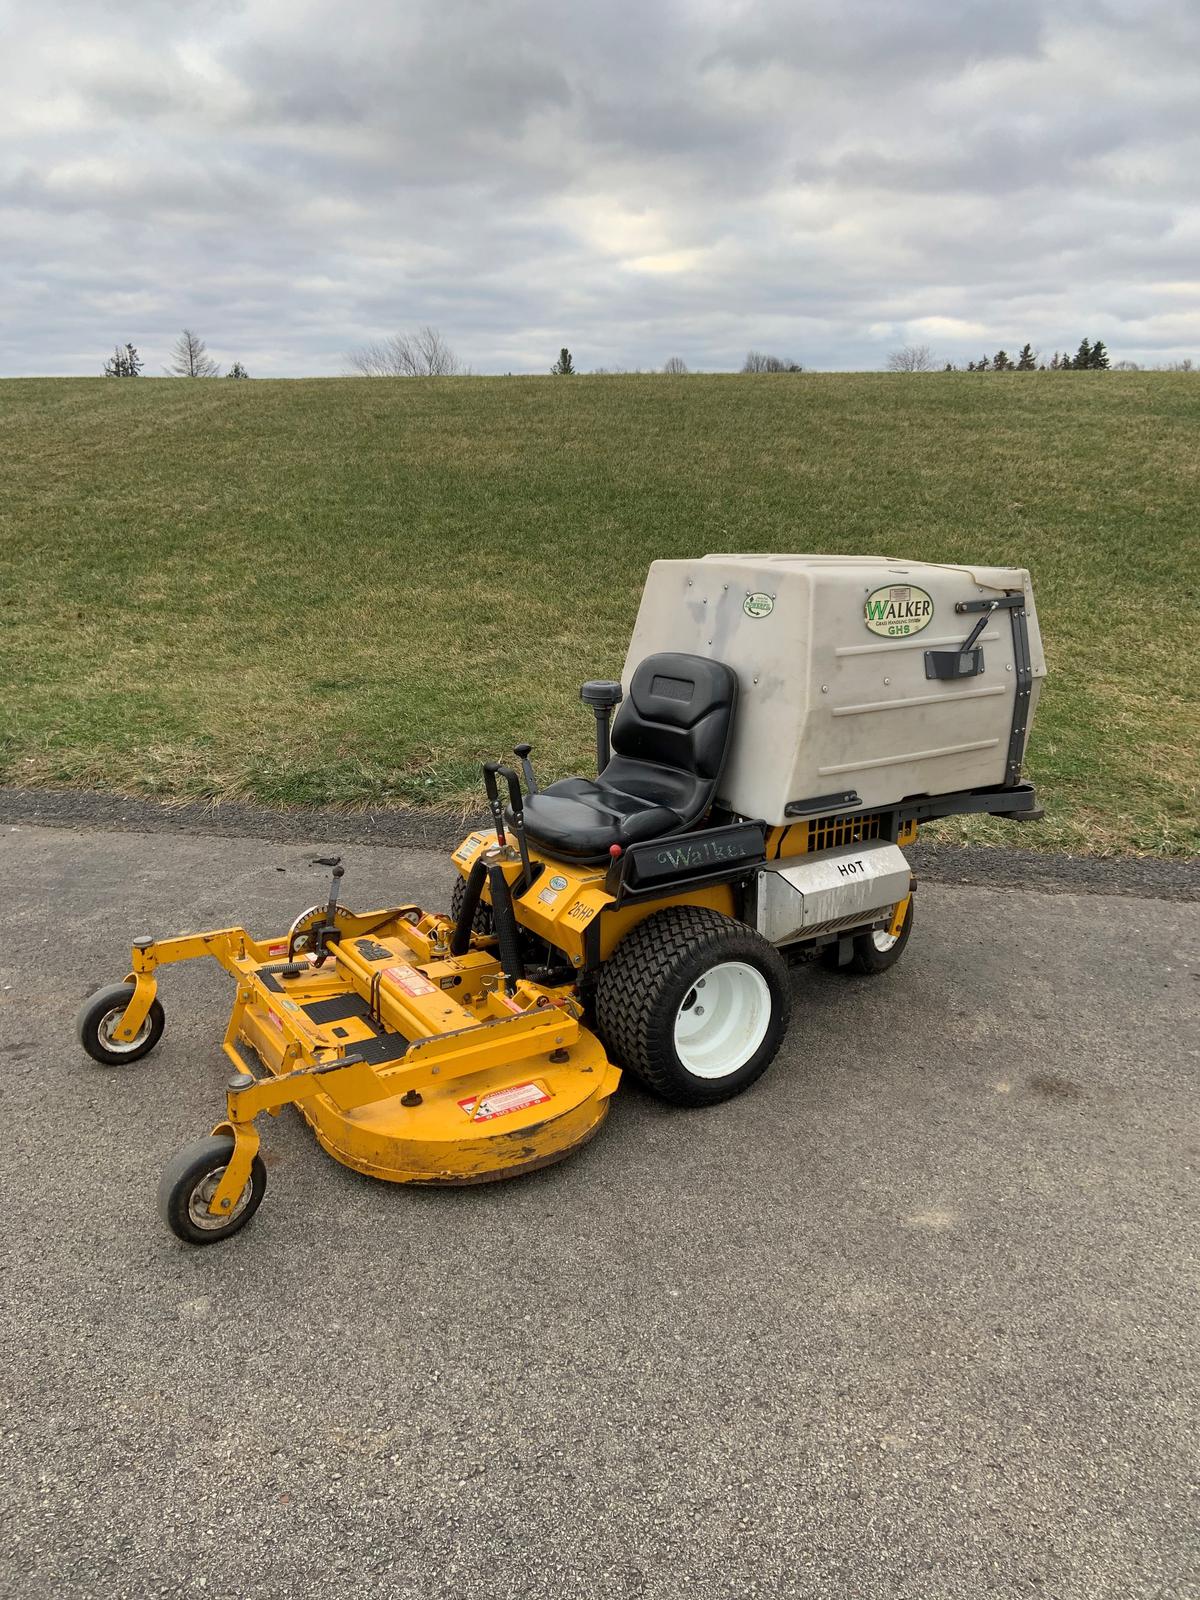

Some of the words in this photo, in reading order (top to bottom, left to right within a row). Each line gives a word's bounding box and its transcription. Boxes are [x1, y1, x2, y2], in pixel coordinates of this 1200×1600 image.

[867, 600, 930, 620] WALKER
[888, 624, 910, 635] GHS
[837, 860, 865, 876] HOT
[567, 901, 595, 922] 26HP
